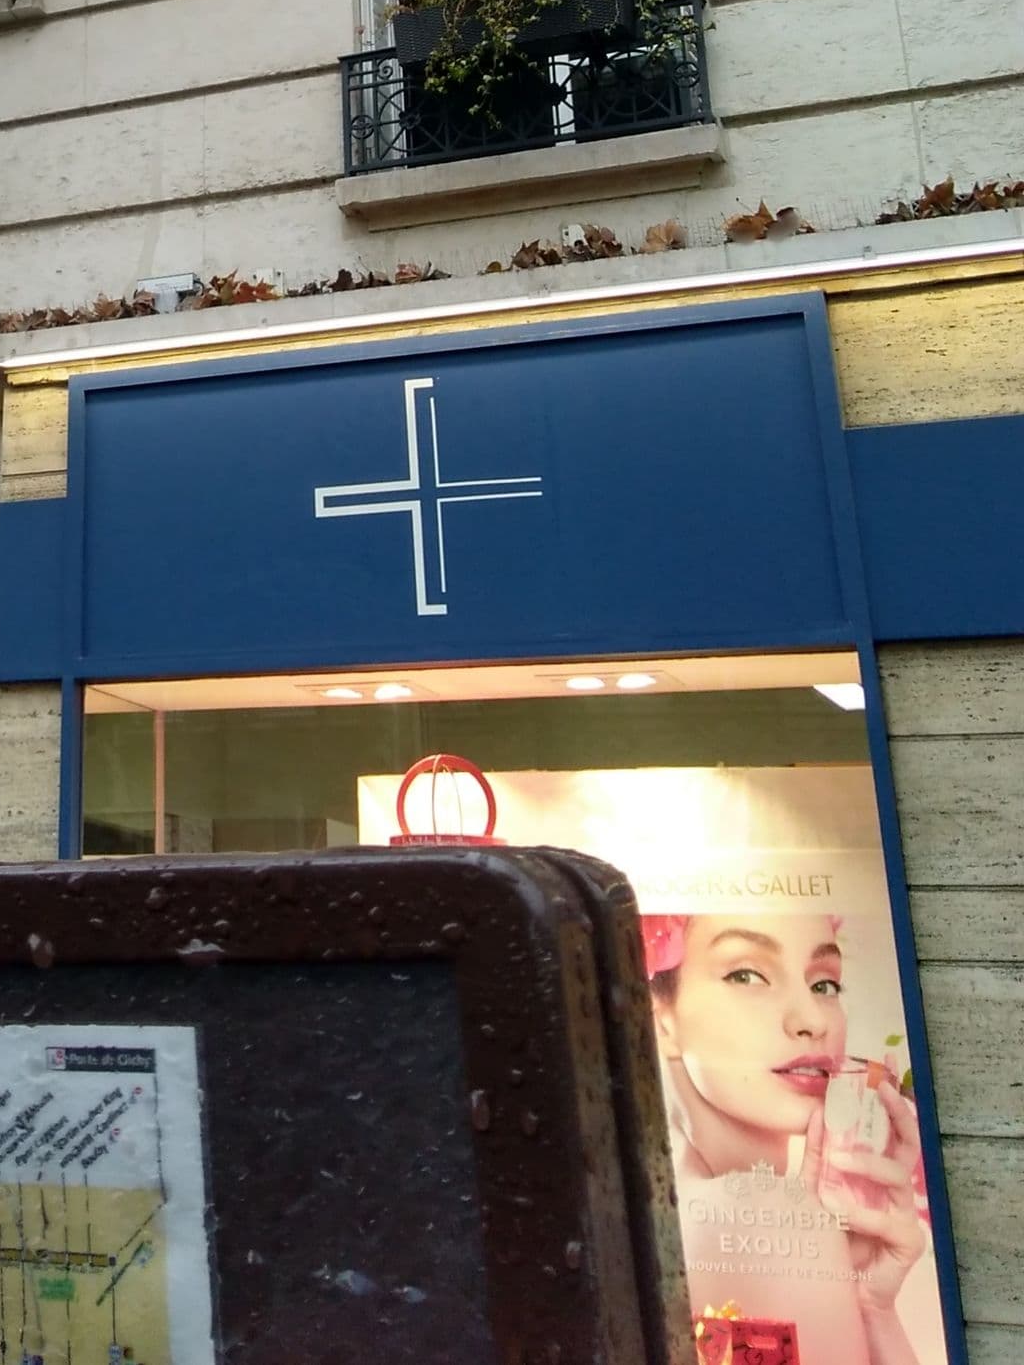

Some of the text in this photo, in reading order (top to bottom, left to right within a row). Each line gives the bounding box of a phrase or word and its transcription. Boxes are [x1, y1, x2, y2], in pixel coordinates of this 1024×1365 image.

[745, 869, 834, 897] GALLET
[687, 1197, 851, 1232] GINGEMBRE
[719, 1234, 821, 1260] EXQUIS
